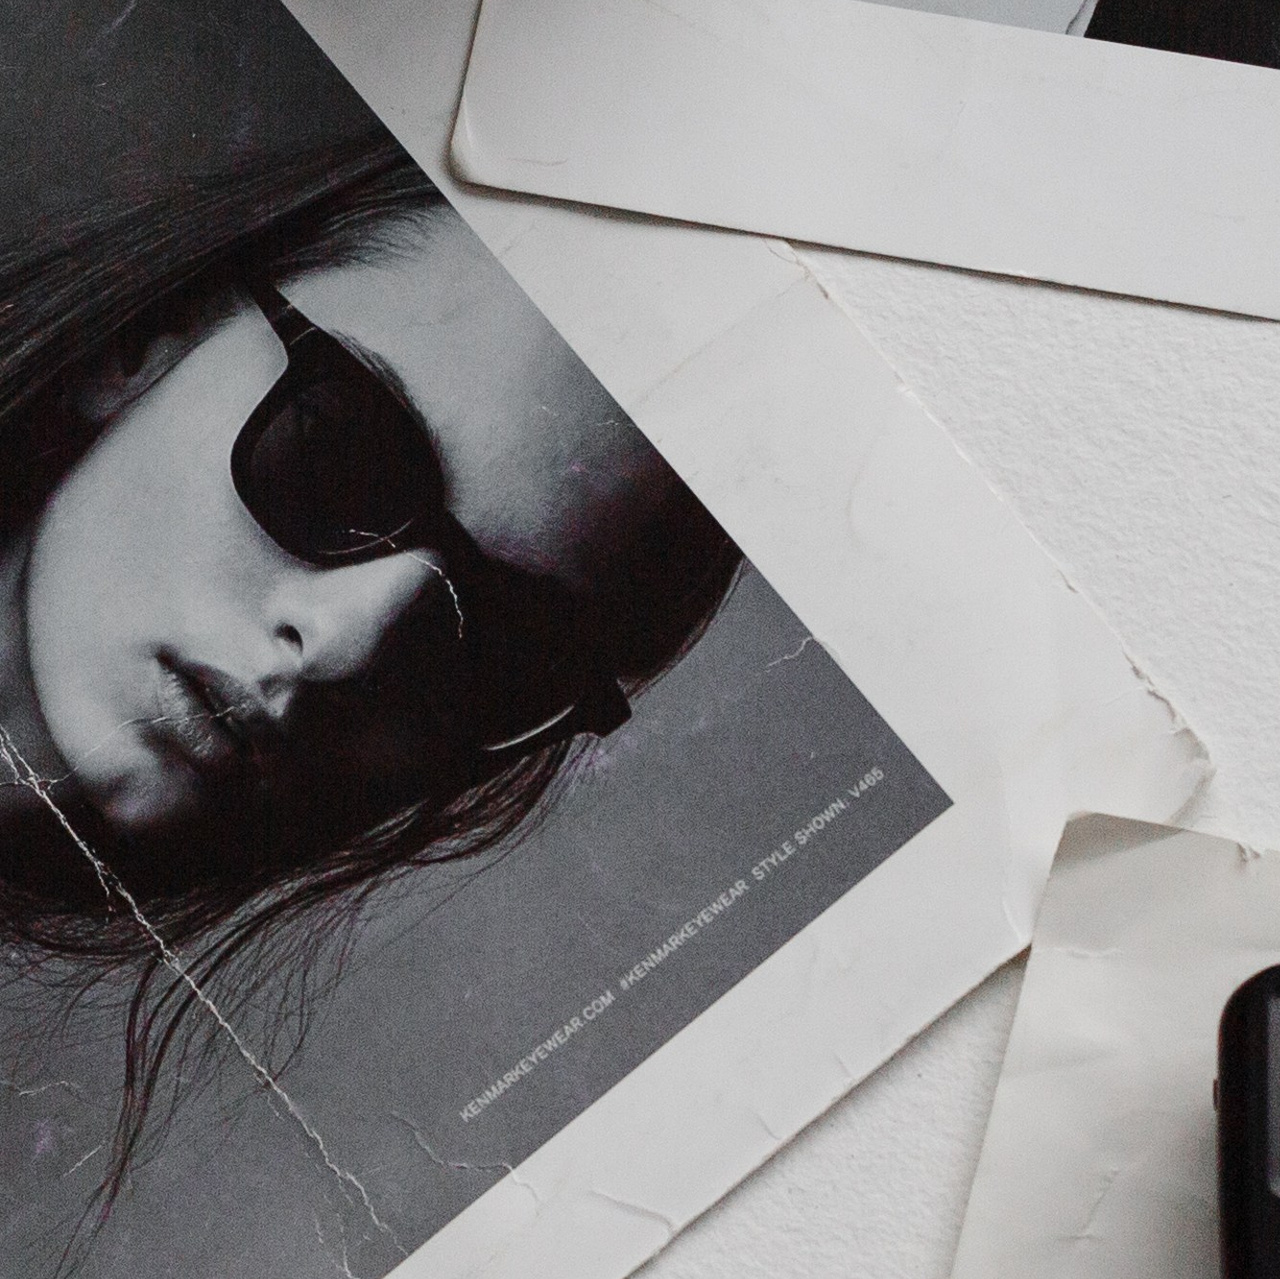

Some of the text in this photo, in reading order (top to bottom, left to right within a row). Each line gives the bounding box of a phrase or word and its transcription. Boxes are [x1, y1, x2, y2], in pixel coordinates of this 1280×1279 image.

[459, 990, 617, 1123] KENMARKEYEWEAR.COM
[619, 879, 750, 991] #KENMARKEYEWEAR
[750, 840, 797, 883] STYLE
